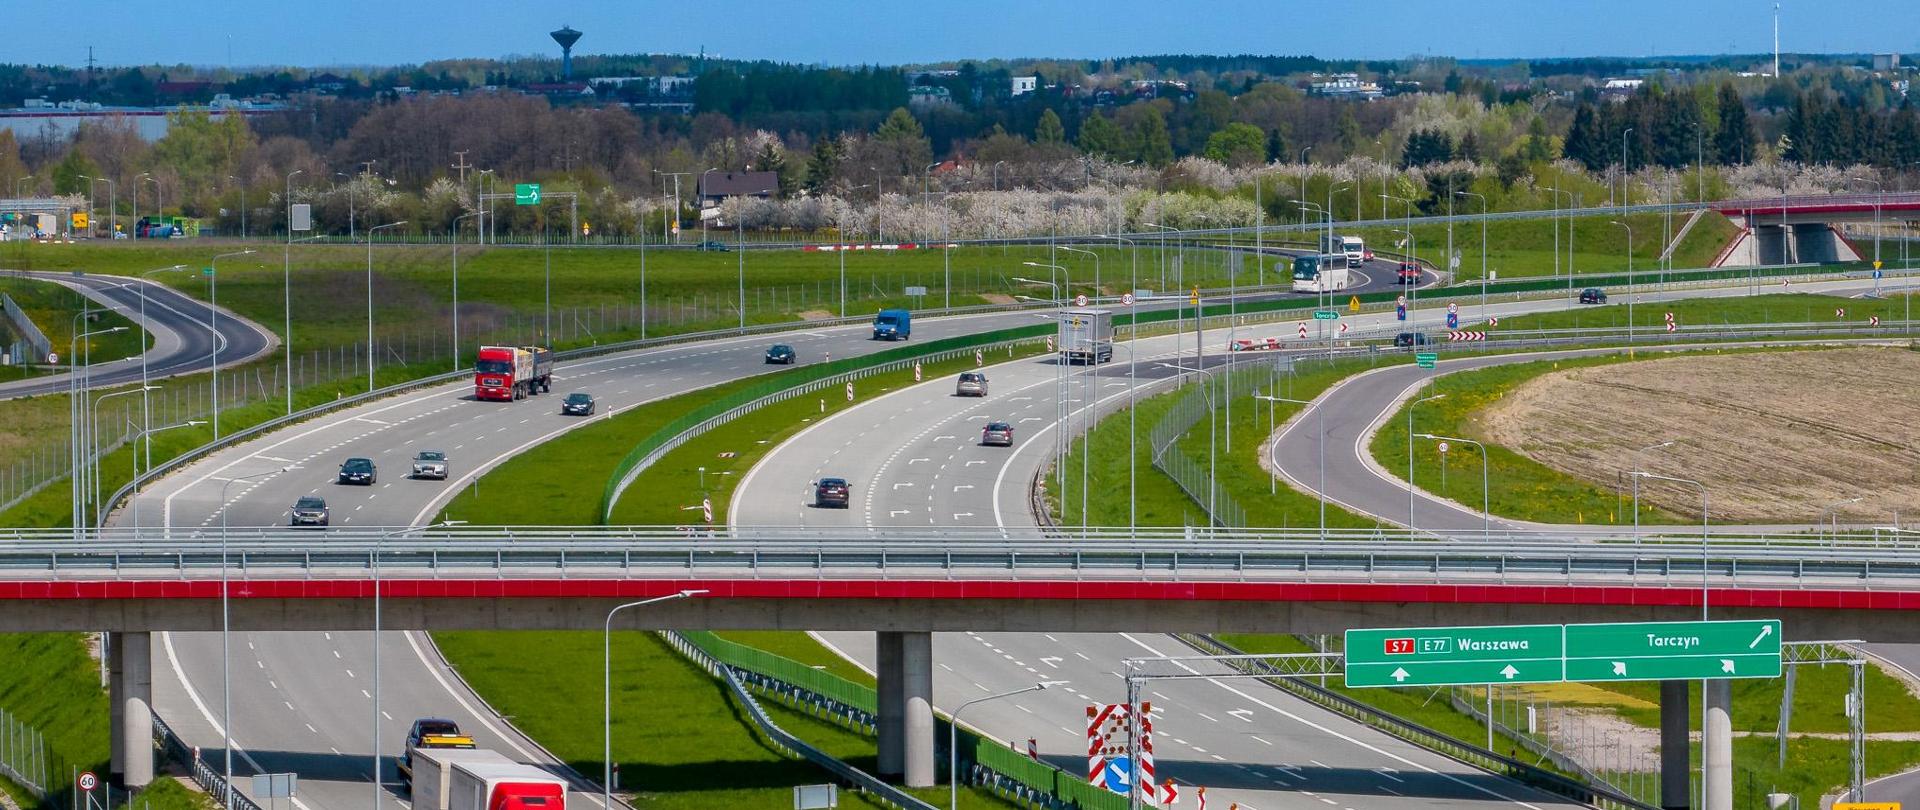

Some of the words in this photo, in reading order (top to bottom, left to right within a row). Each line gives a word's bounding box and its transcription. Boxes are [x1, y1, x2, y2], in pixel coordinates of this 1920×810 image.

[1457, 638, 1529, 651] Warszawa
[1646, 633, 1700, 650] Tarczyn
[81, 777, 94, 786] 60
